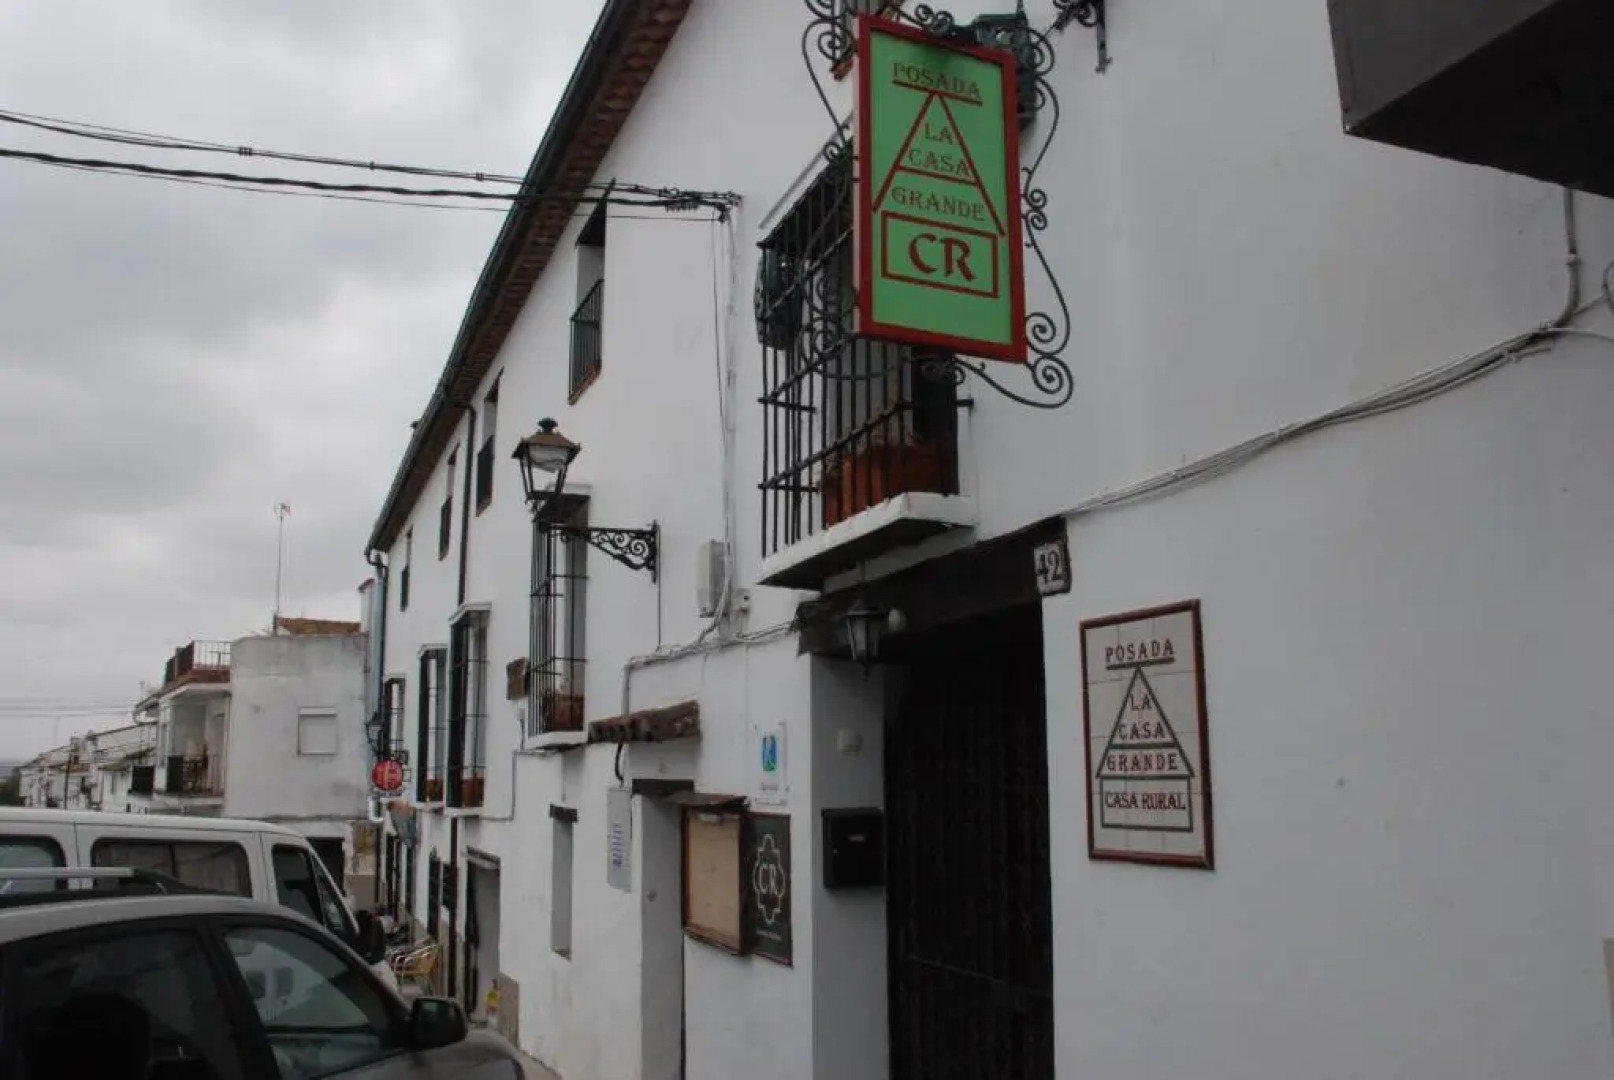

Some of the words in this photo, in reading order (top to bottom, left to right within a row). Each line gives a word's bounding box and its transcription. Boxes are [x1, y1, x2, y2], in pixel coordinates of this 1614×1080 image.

[892, 62, 982, 99] POSADA
[924, 121, 953, 145] LA
[908, 148, 972, 178] CASA
[891, 187, 985, 222] GRANDE
[908, 233, 975, 282] CR
[1036, 552, 1062, 583] 42
[1105, 638, 1175, 662] POSADA
[1130, 694, 1151, 711] LA
[1118, 722, 1165, 740] CASA
[1106, 753, 1179, 771] GRANDE
[1105, 792, 1139, 808] CASA
[1142, 792, 1186, 810] RURAL
[759, 863, 778, 896] CR
